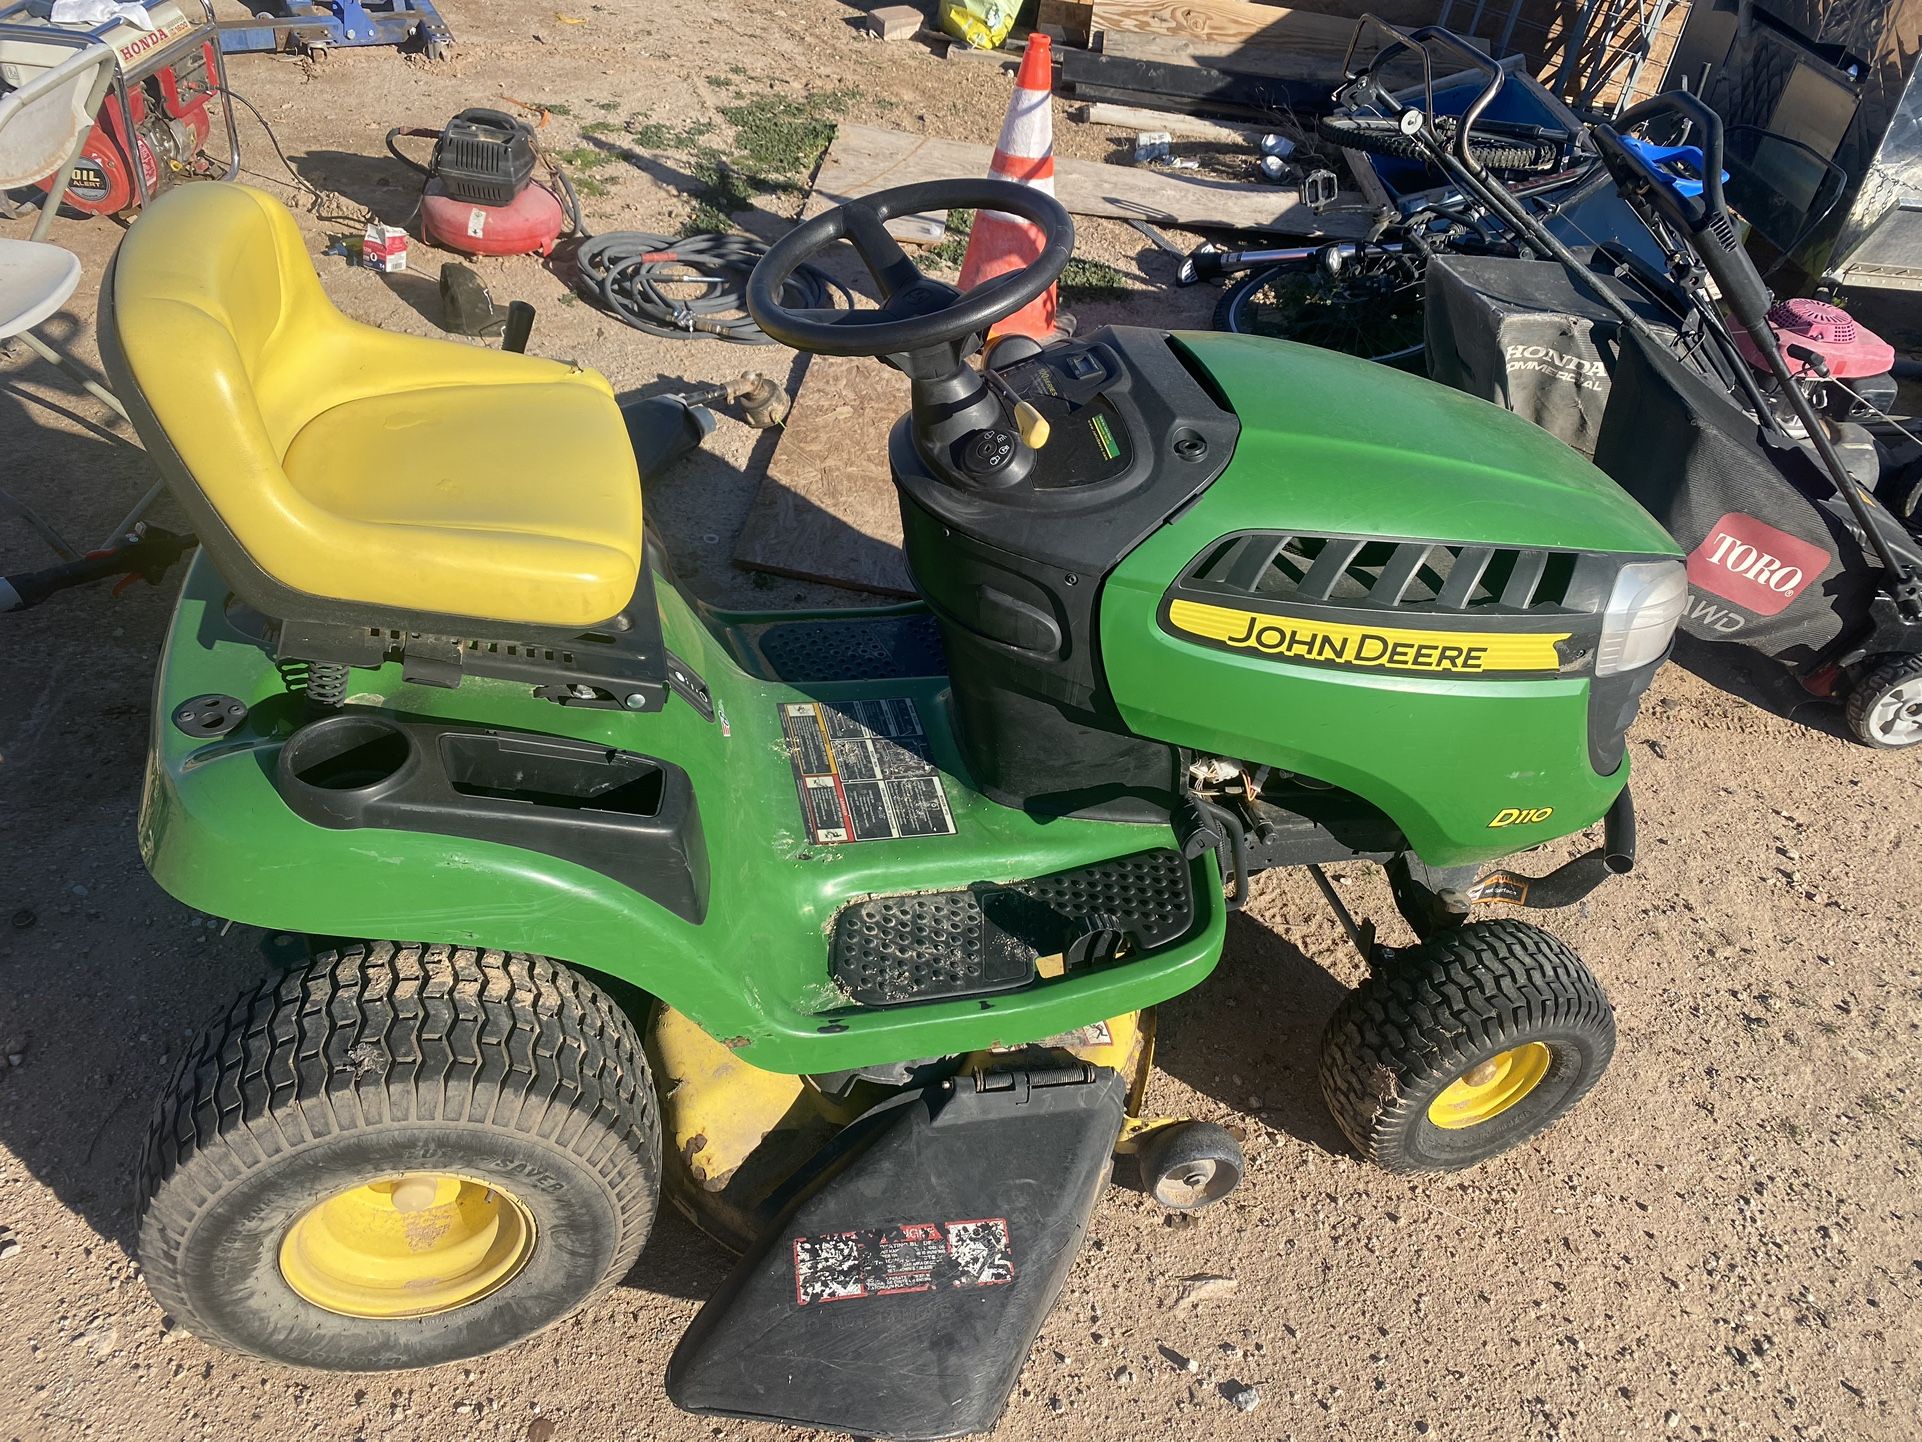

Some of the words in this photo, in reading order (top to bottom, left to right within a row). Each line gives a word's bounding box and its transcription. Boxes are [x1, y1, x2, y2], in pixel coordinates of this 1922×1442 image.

[120, 28, 168, 60] HONDA
[71, 169, 100, 182] OIL
[1505, 361, 1602, 391] OMMERCAL
[1506, 345, 1608, 377] HONDA
[1706, 533, 1803, 592] TORO
[1228, 617, 1349, 660] JOHN
[1353, 633, 1488, 670] DEERE
[1486, 806, 1554, 829] D110
